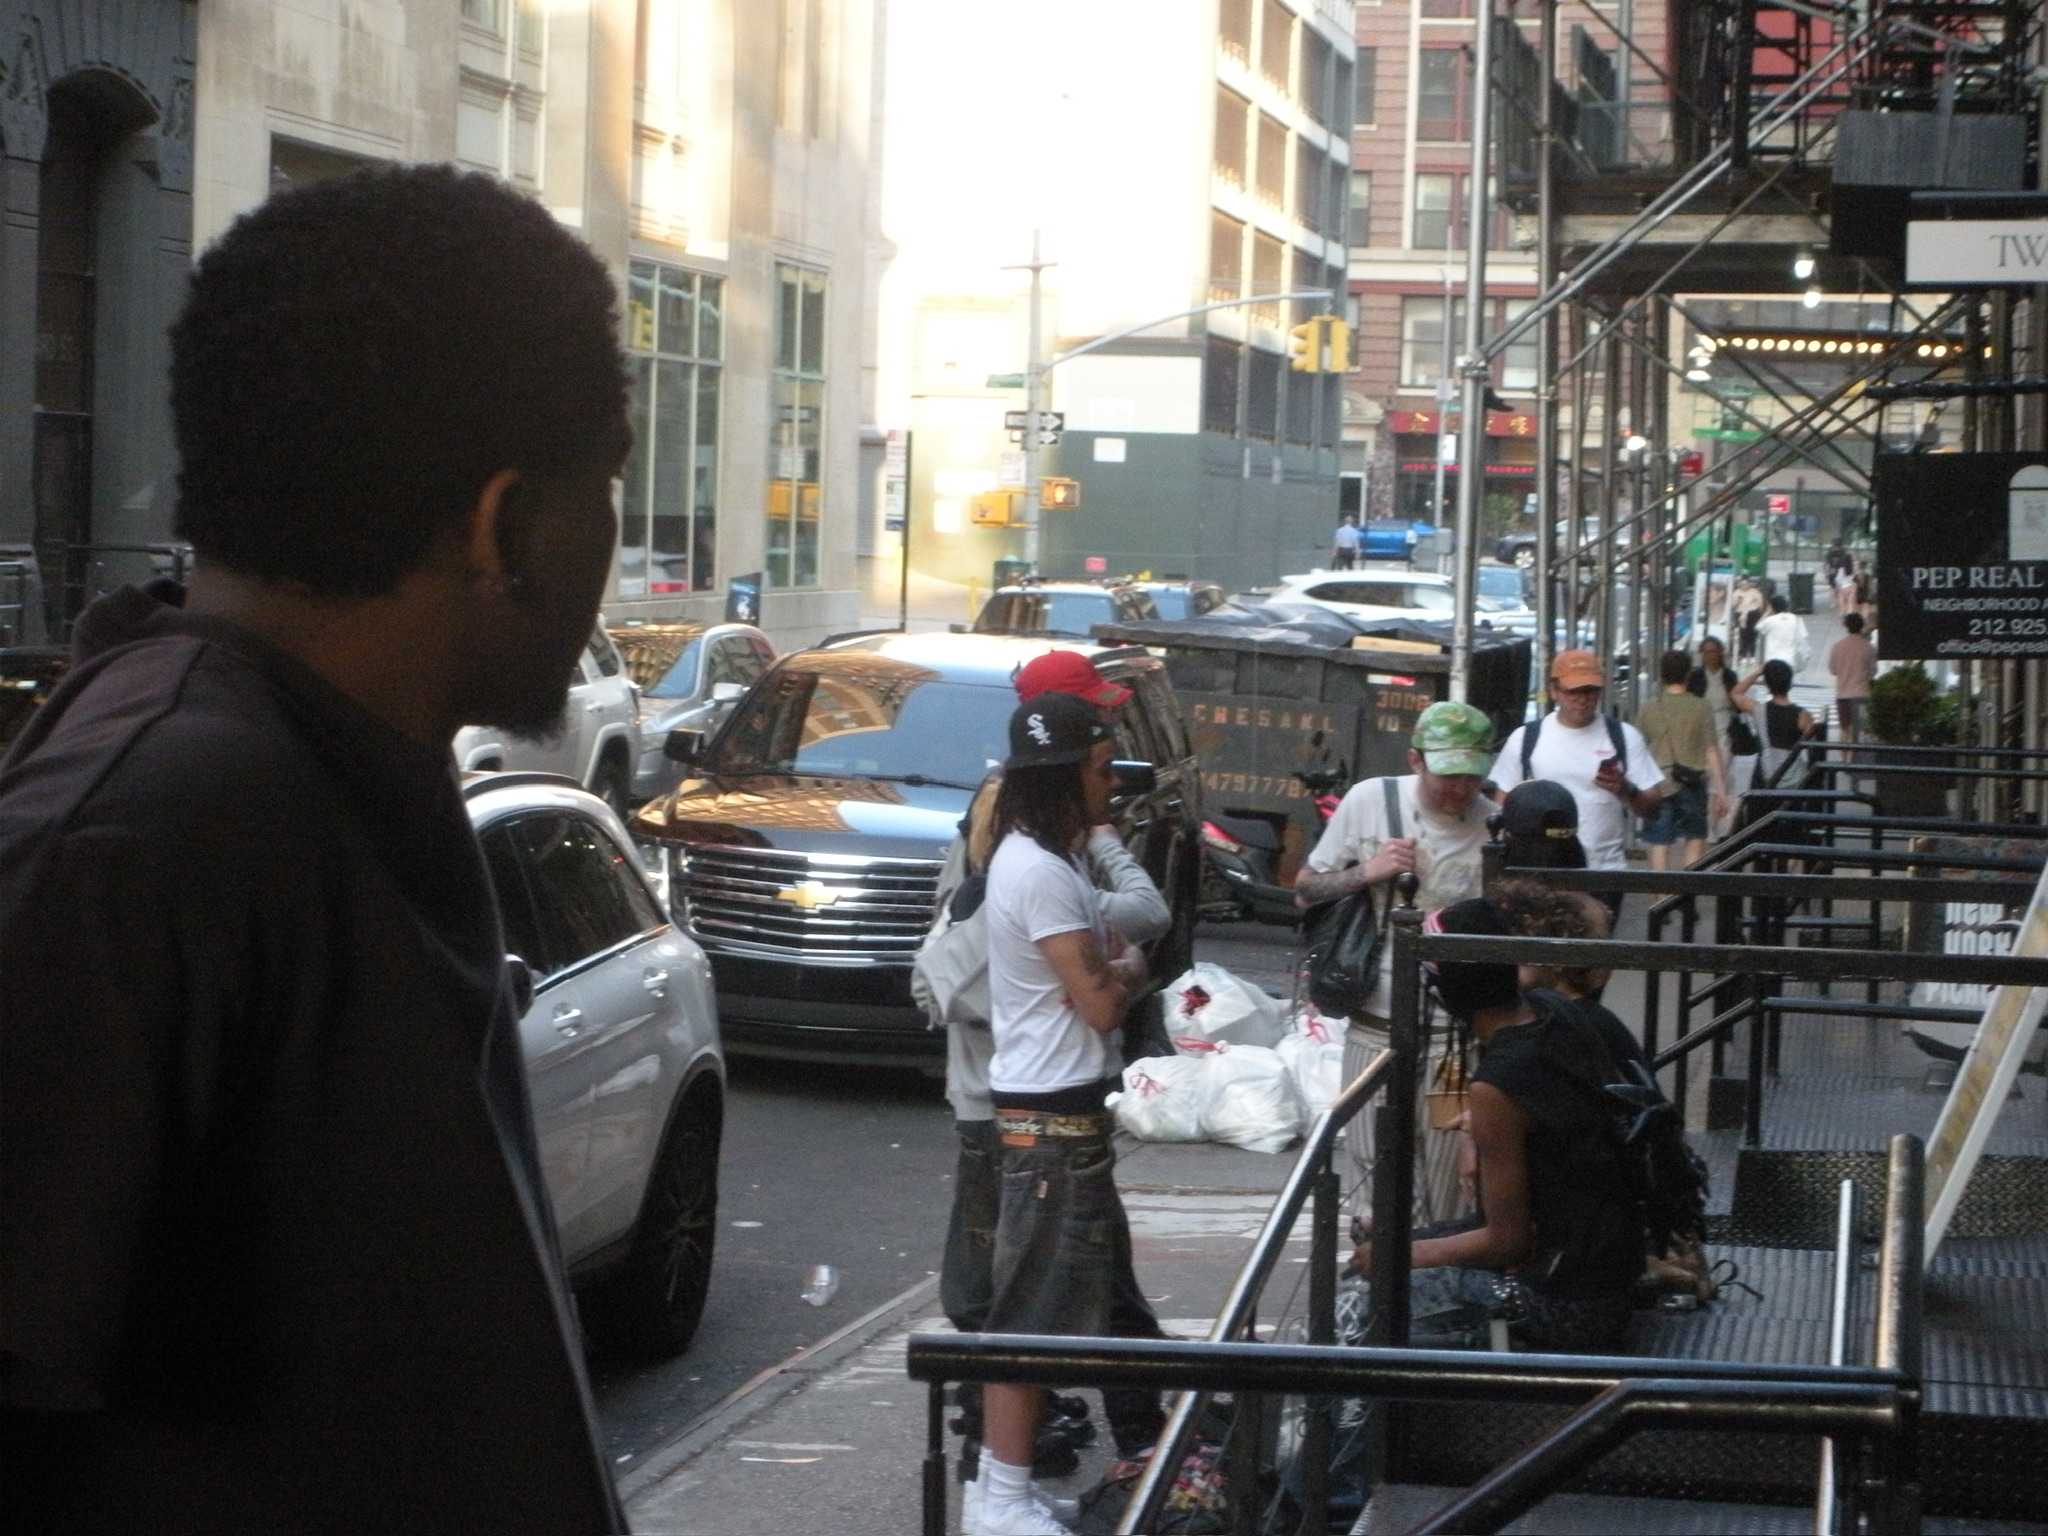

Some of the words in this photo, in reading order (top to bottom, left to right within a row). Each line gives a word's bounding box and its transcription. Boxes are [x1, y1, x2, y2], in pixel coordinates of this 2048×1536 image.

[1912, 566, 1962, 589] PEP
[1968, 566, 2045, 589] REAL
[1922, 597, 2041, 612] NEIGHBORHOOD
